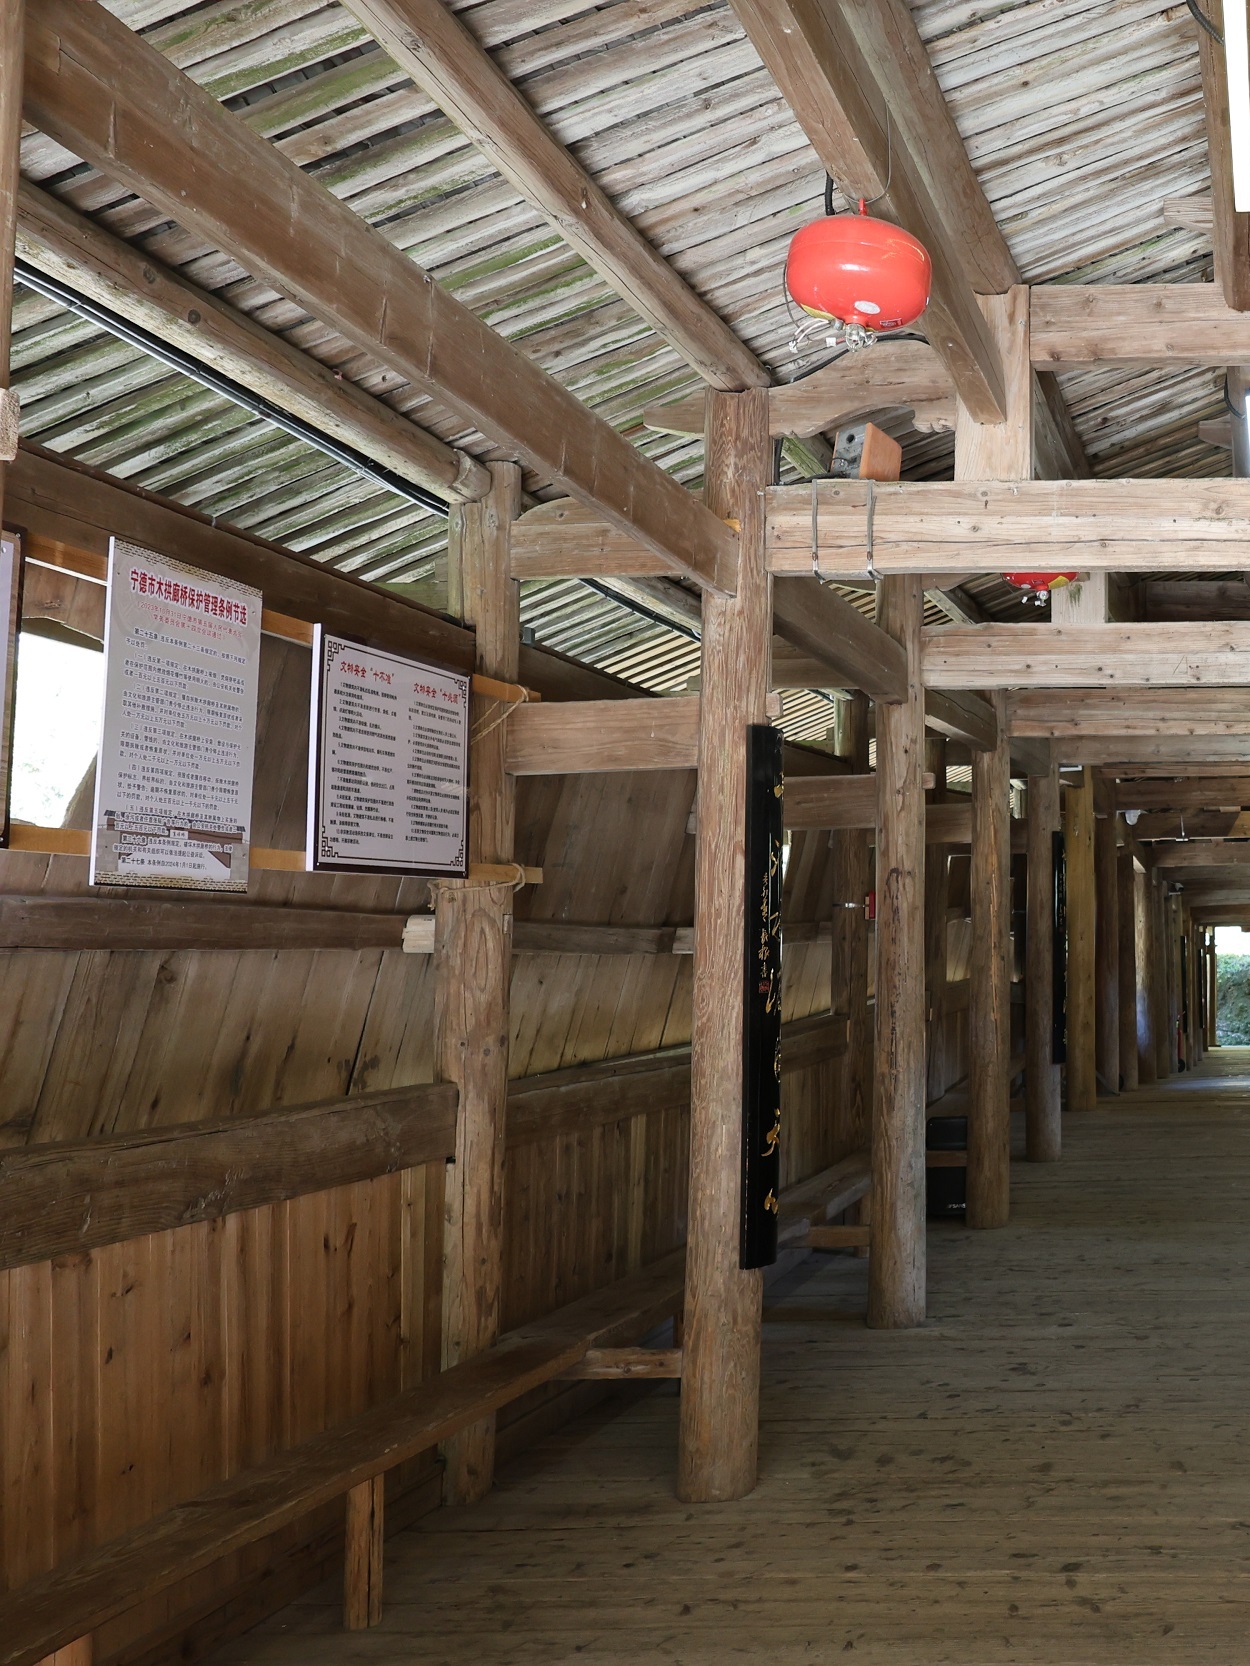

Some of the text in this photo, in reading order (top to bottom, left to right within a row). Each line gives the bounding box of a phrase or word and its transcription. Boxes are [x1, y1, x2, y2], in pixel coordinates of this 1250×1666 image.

[131, 568, 247, 625] 宁德市木拱廊桥保护管理条例节选
